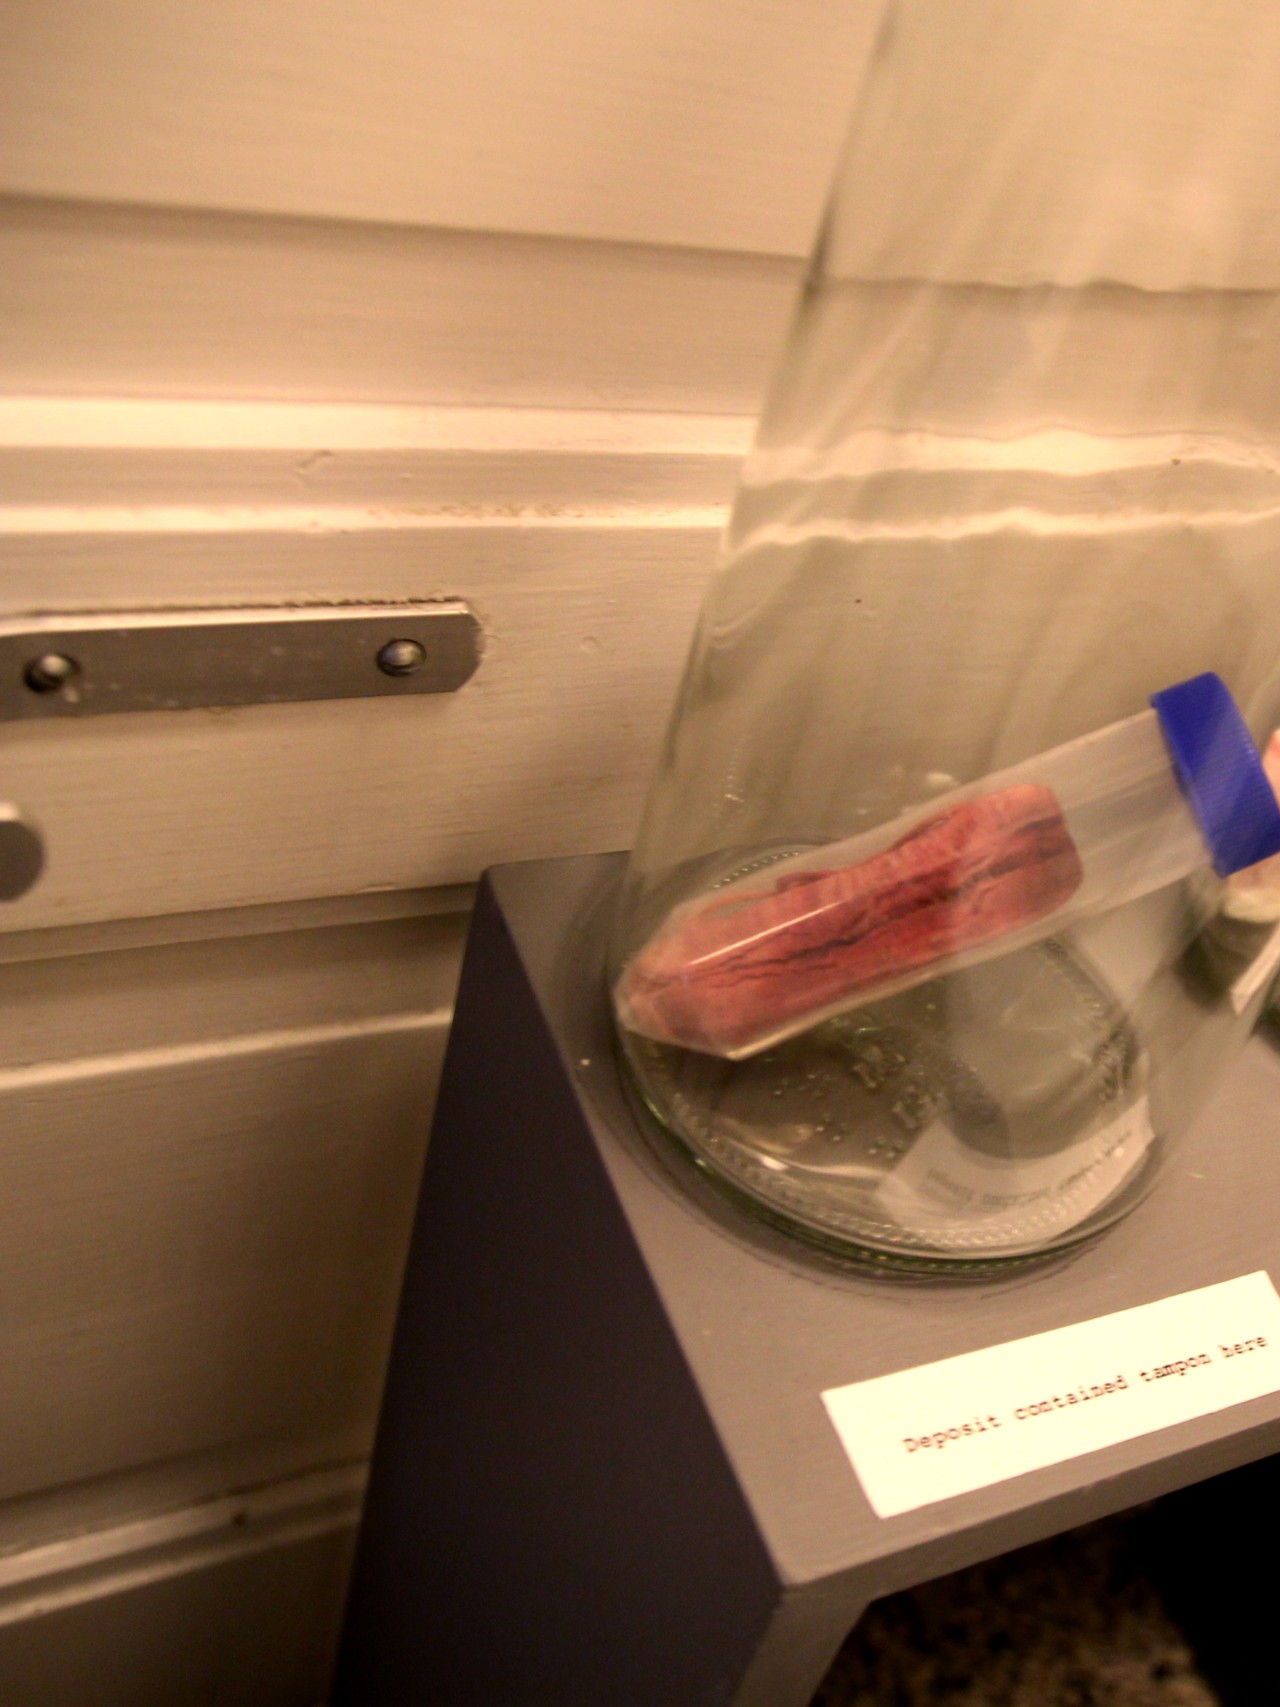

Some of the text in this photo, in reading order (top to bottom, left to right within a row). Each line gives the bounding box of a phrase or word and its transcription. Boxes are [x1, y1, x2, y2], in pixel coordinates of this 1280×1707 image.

[902, 1335, 1268, 1454] Deposit contained tampon here
